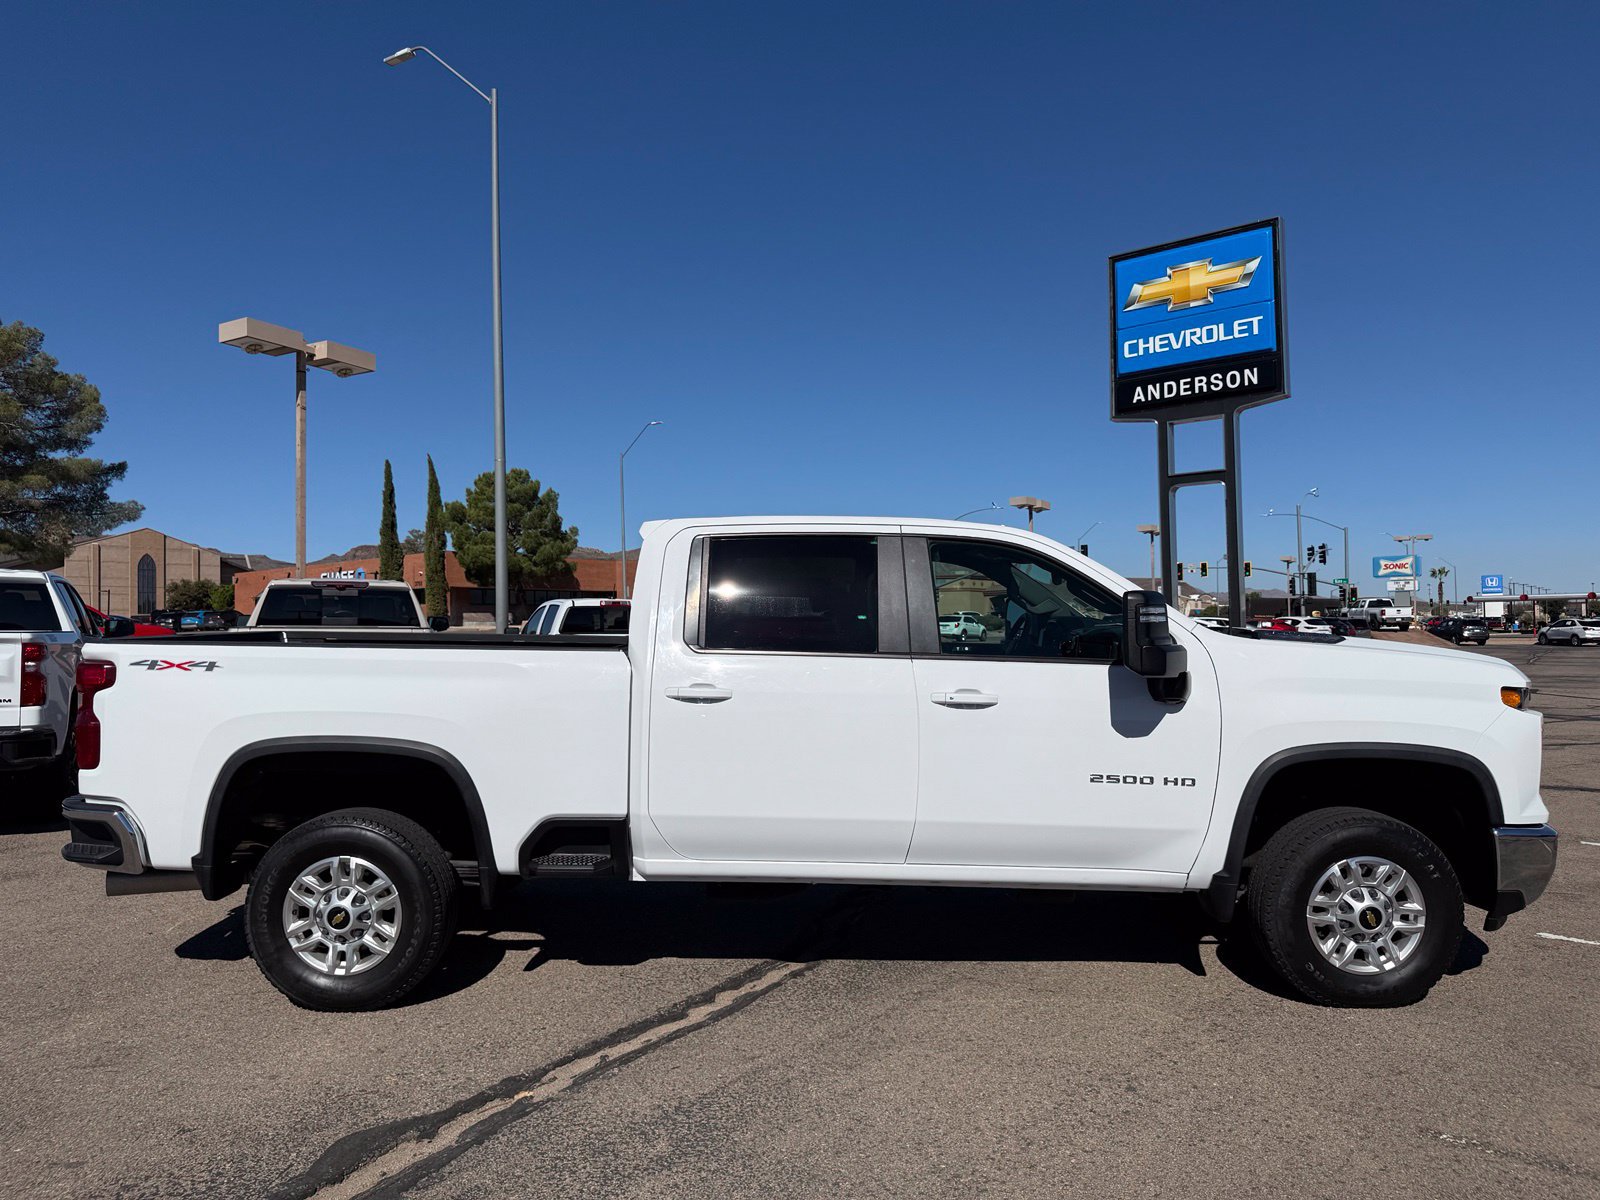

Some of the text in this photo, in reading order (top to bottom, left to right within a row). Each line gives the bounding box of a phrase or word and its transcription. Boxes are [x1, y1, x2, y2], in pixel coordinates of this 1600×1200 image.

[1123, 315, 1264, 359] CHEVROLET
[1132, 367, 1259, 404] ANDERSON
[1382, 562, 1409, 570] SONIC
[1089, 773, 1196, 787] 2500 HD
